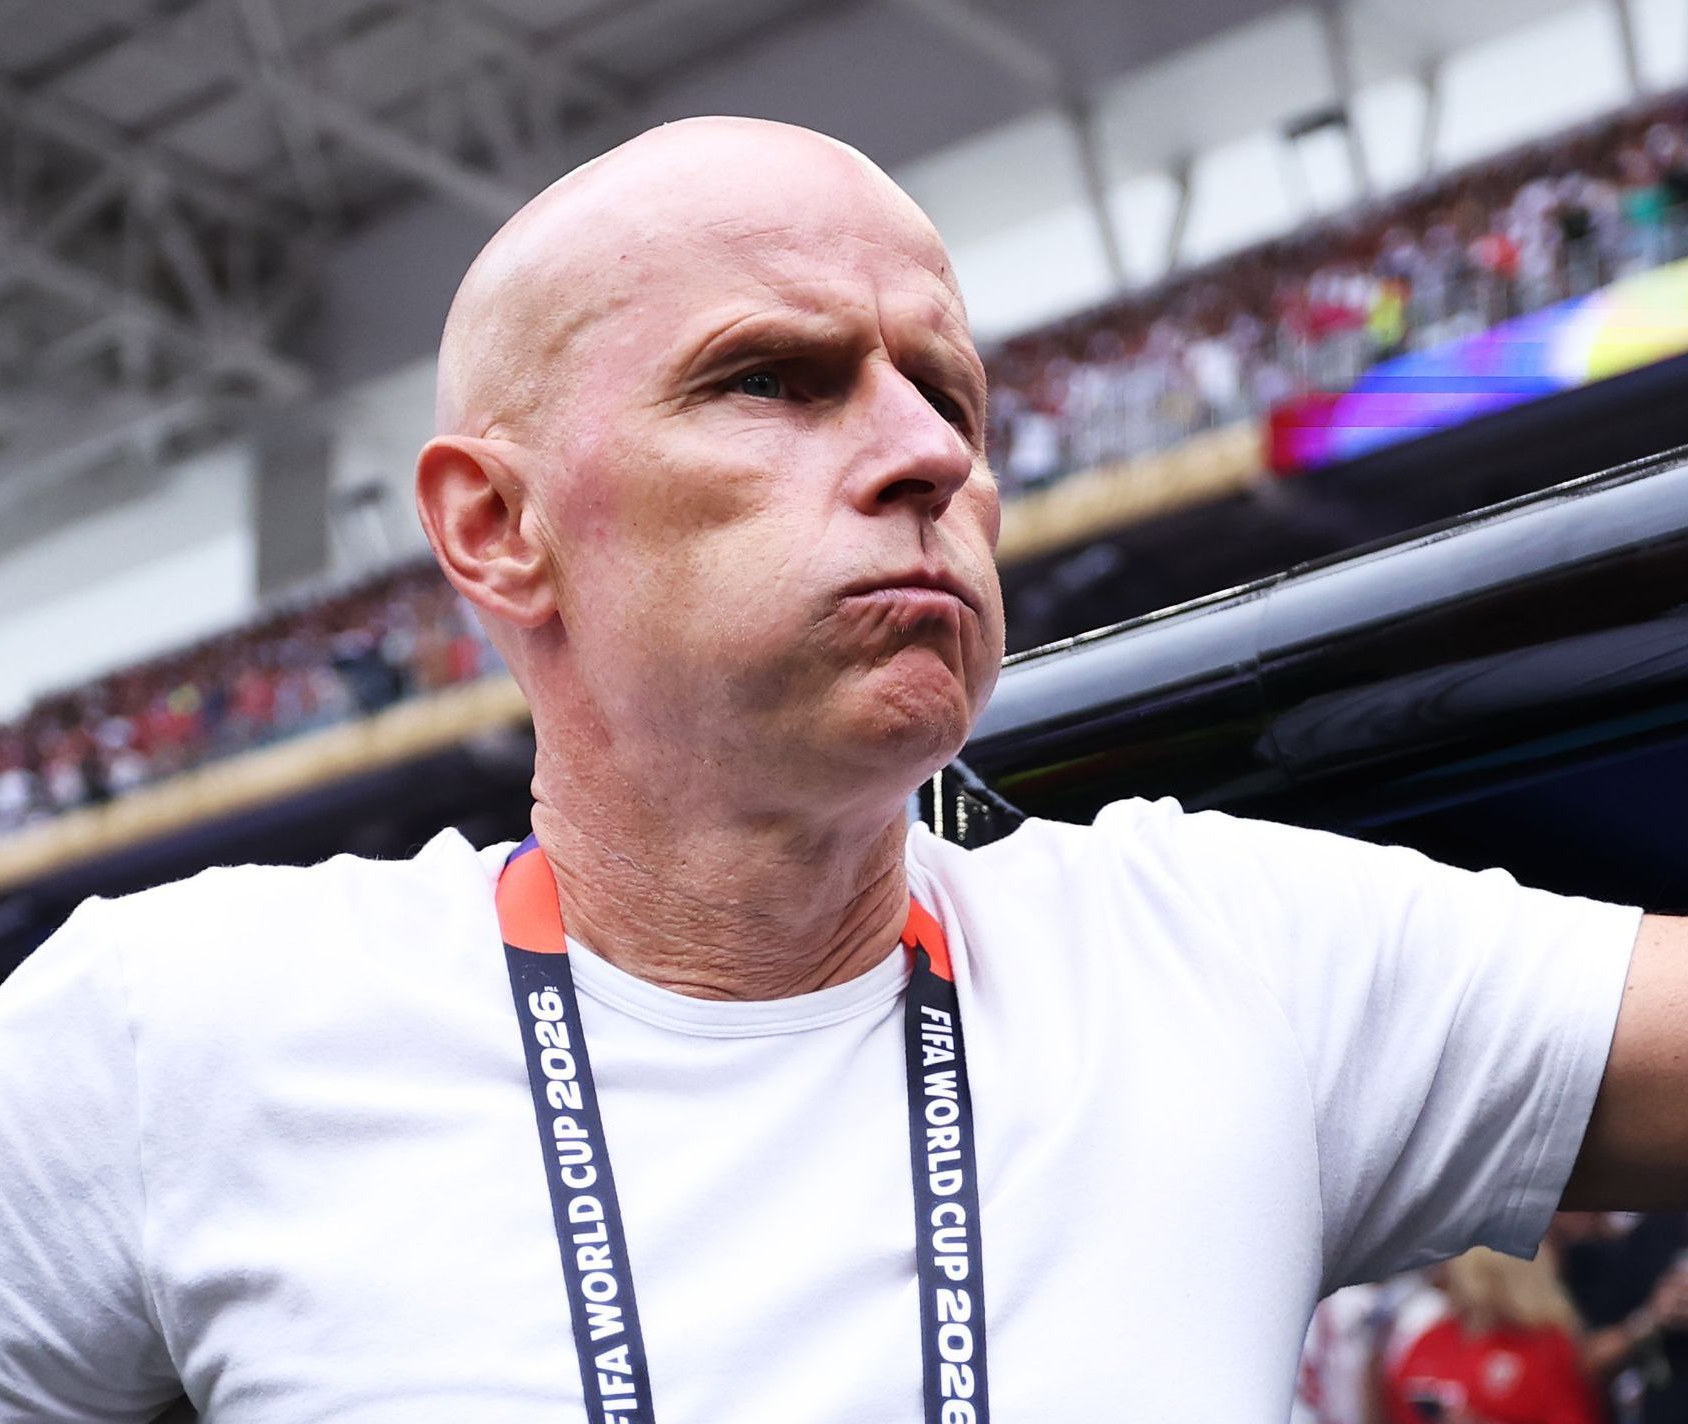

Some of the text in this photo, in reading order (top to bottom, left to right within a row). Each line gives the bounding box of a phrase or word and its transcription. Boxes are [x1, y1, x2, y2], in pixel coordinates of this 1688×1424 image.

[528, 991, 584, 1110] 2026
[920, 1005, 956, 1067] FIFA
[552, 1115, 598, 1189] CUP
[923, 1069, 964, 1197] WORLD
[567, 1195, 625, 1342] WORLD
[930, 1202, 969, 1281] CUP
